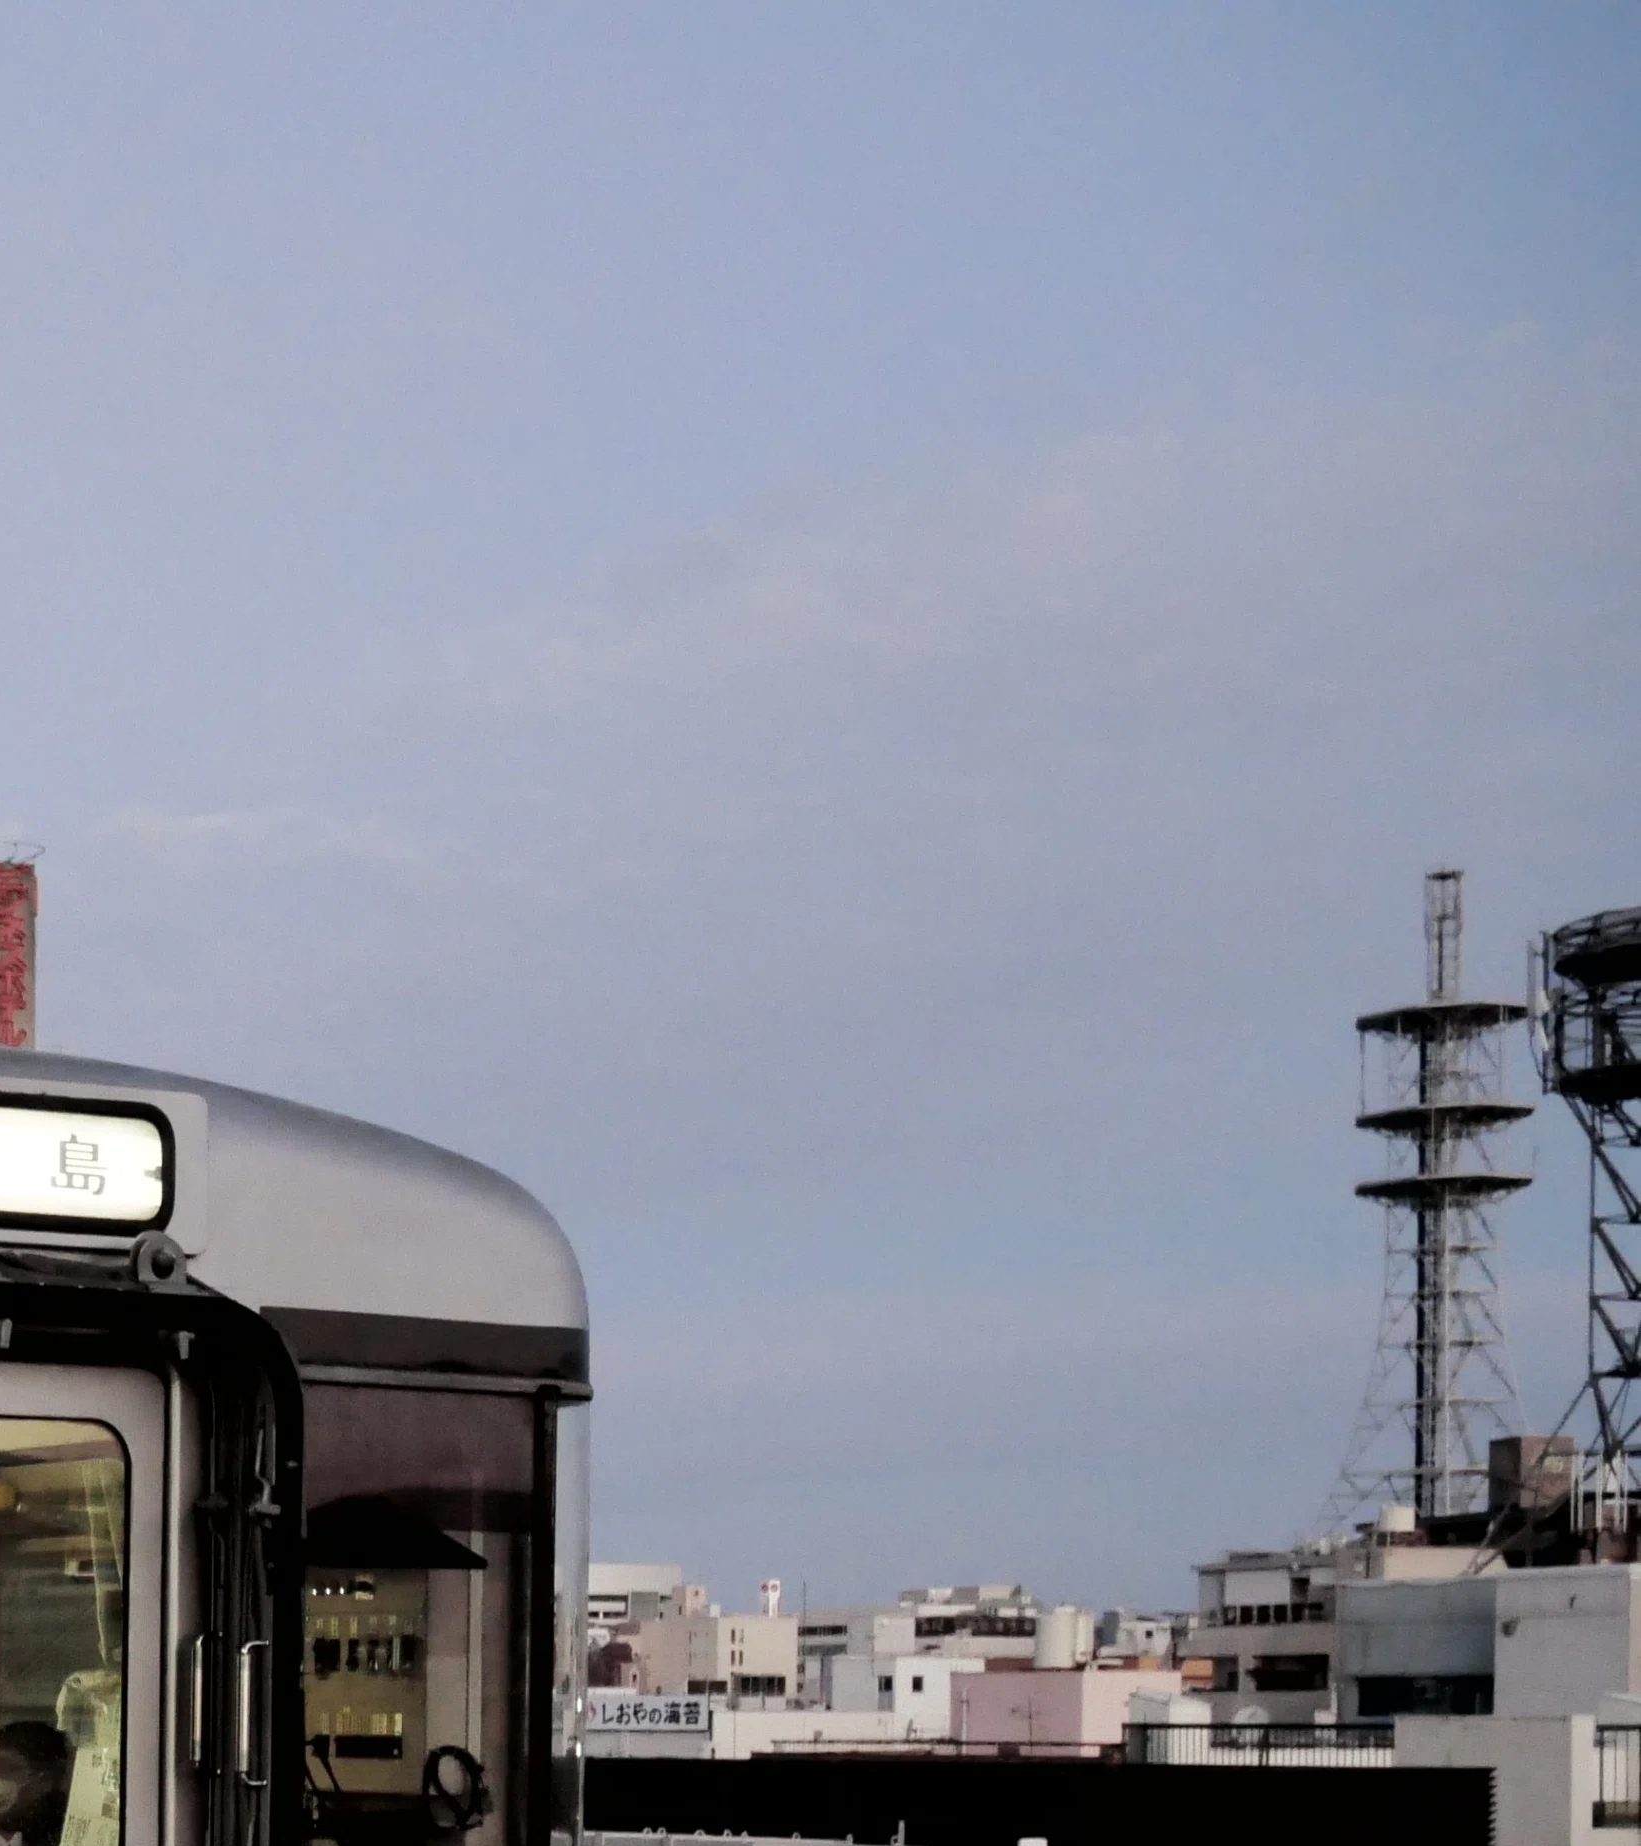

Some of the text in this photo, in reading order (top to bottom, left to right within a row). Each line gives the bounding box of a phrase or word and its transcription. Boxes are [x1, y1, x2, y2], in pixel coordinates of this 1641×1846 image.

[602, 1702, 701, 1725] しおやの海苔
